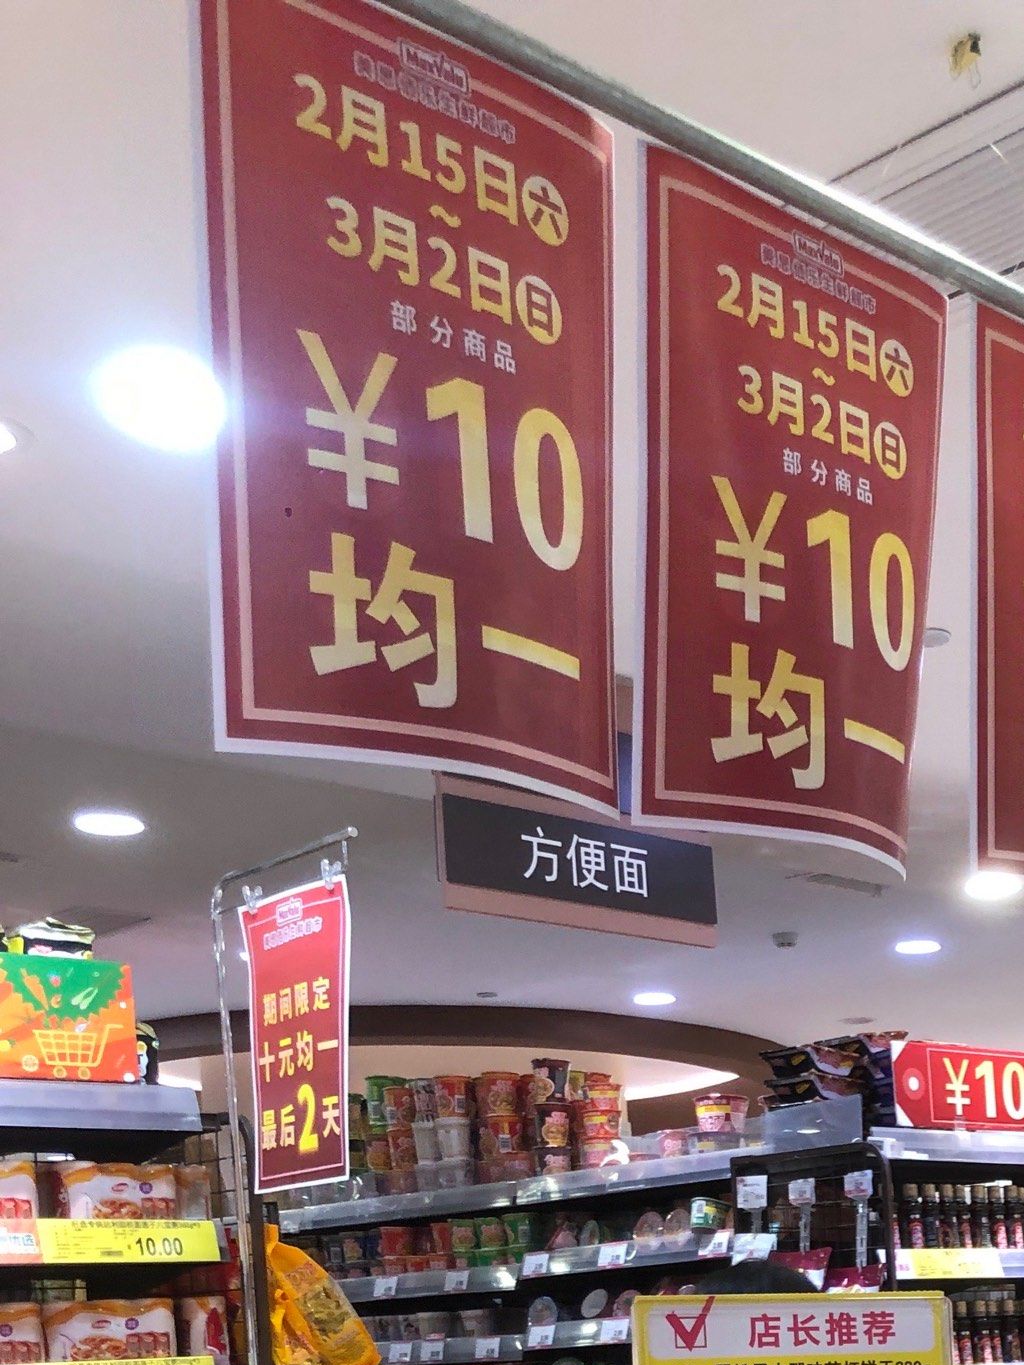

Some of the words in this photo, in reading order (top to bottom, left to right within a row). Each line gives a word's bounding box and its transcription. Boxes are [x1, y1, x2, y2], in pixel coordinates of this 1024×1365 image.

[391, 300, 516, 375] 部分商品
[783, 448, 873, 505] 部分商品
[309, 532, 580, 708] 均一
[711, 642, 906, 790] 均一
[521, 826, 649, 898] 方便面
[262, 977, 331, 1027] 期间限定
[258, 1030, 339, 1083] 十元均一
[261, 1083, 341, 1154] 最后2天
[135, 1237, 184, 1257] 10.00
[748, 1311, 896, 1348] 店长推荐
